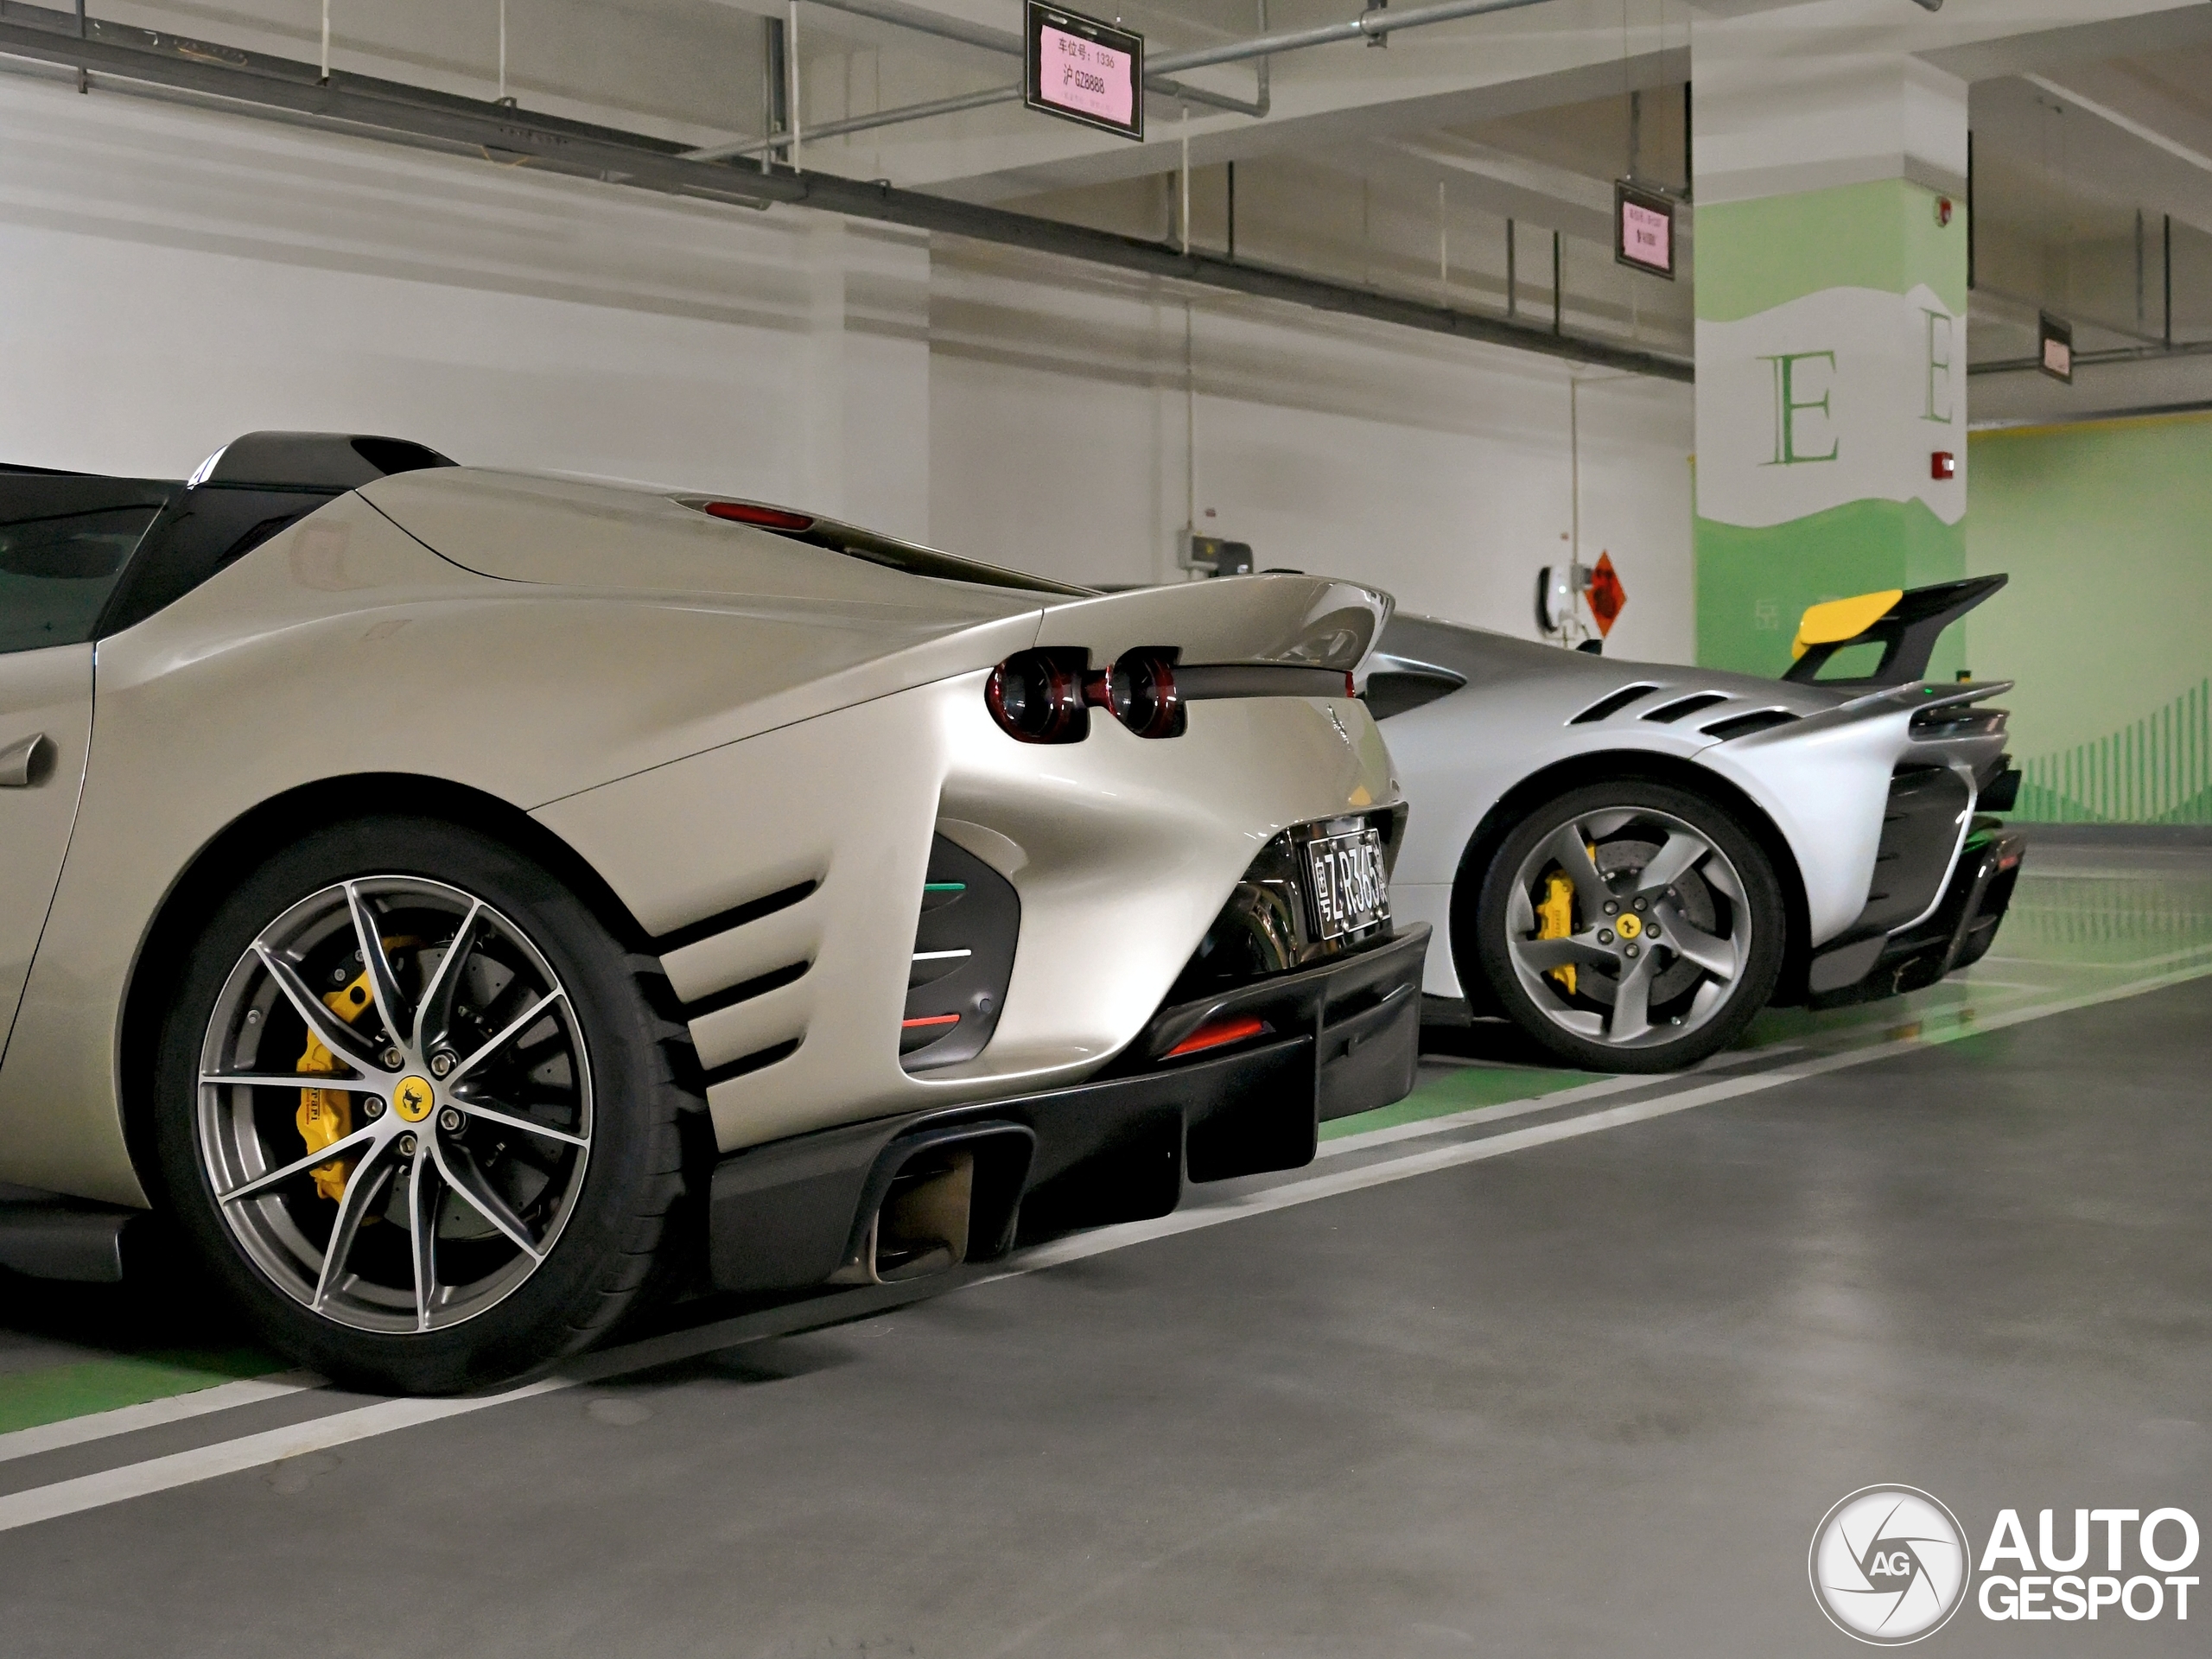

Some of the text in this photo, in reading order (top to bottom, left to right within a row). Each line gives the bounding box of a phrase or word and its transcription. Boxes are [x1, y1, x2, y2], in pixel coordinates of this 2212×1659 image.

[1075, 70, 1105, 94] GZ8888
[1096, 51, 1116, 69] 1336
[1917, 306, 1953, 424] E
[1755, 350, 1839, 467] E
